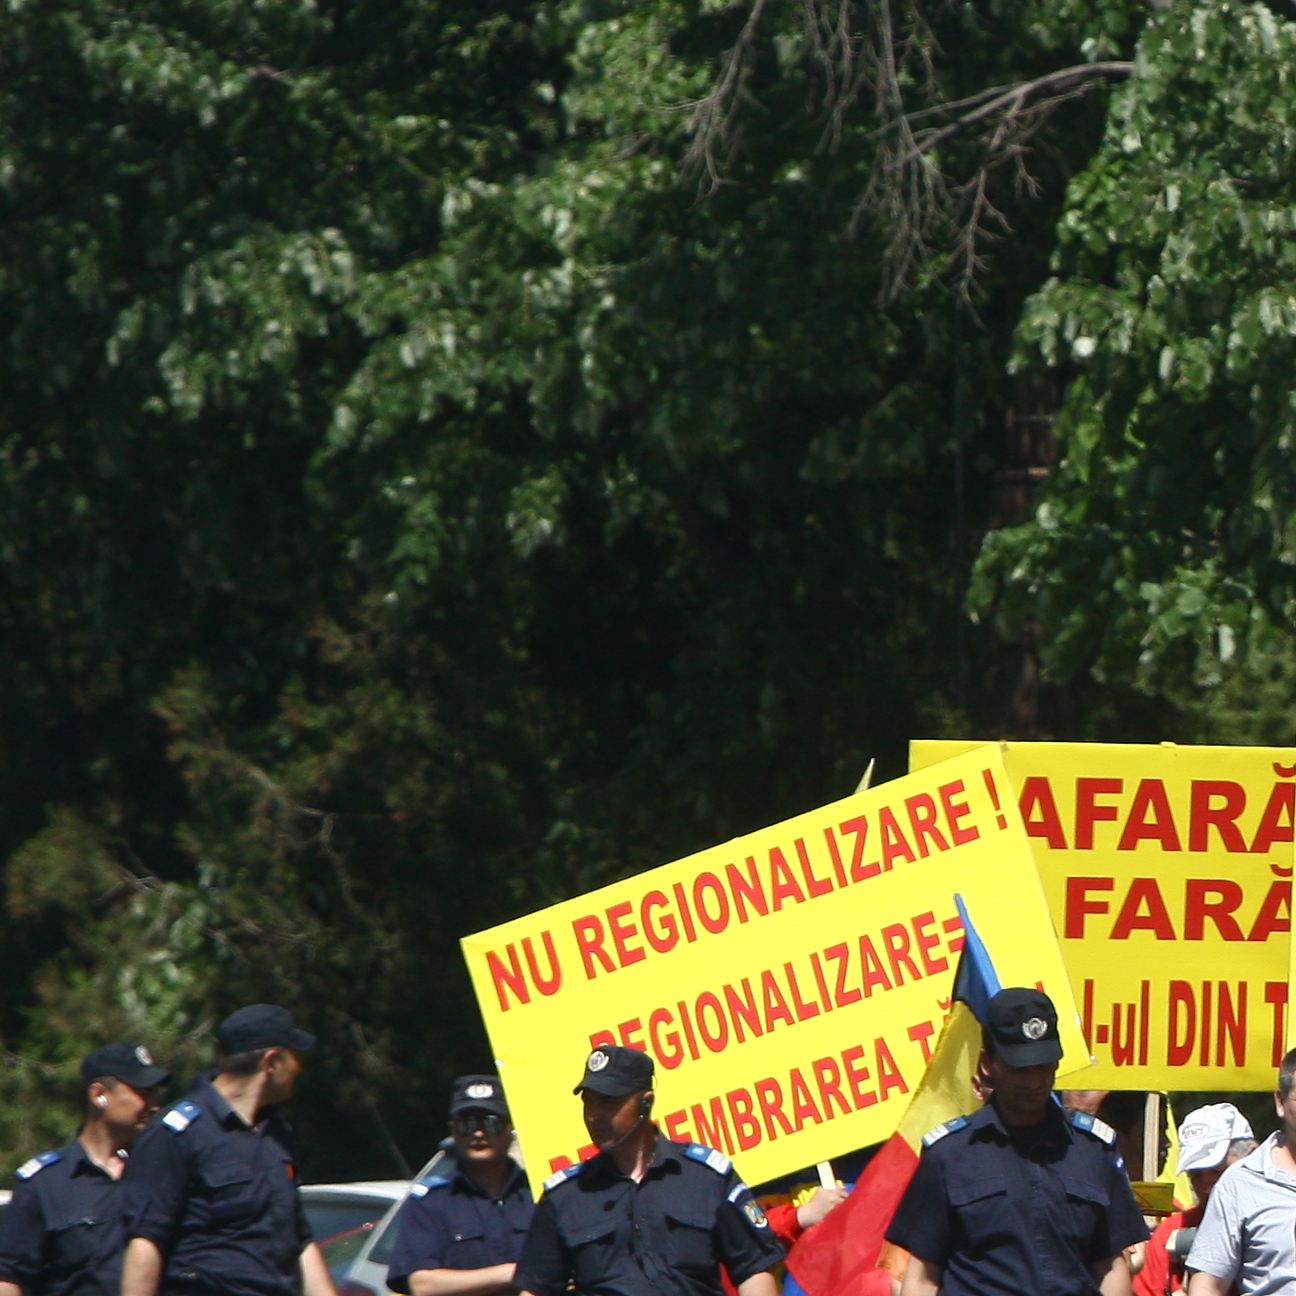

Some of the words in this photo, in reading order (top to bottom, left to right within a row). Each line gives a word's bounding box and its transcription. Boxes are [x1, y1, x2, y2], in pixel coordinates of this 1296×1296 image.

[1019, 762, 1296, 853] AFARĂ
[484, 930, 562, 1012] NU
[571, 777, 980, 980] REGIONALIZARE
[980, 767, 1009, 830] !
[1060, 864, 1292, 941] FARĂ
[1166, 979, 1247, 1067] DIN
